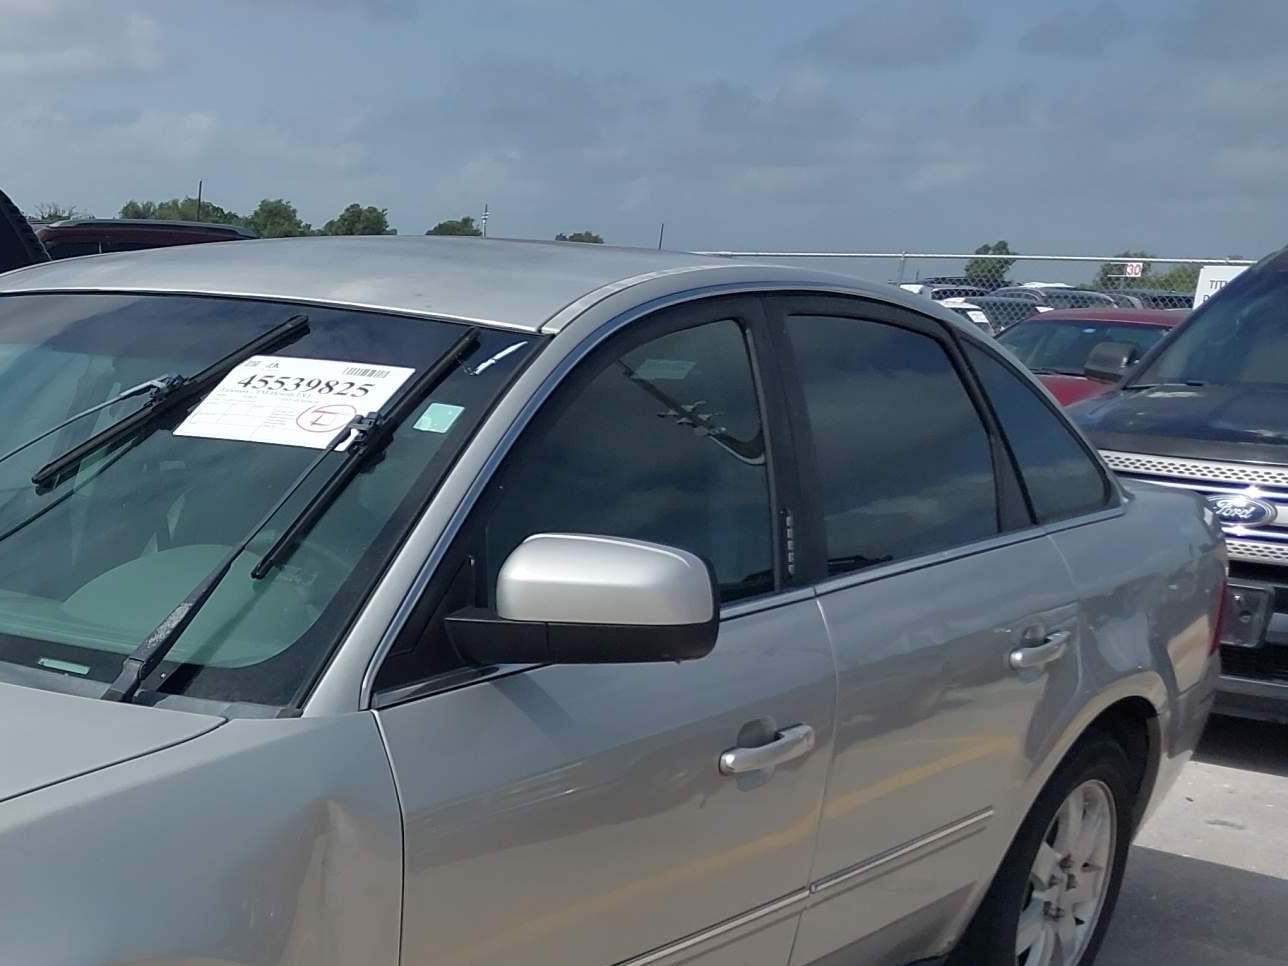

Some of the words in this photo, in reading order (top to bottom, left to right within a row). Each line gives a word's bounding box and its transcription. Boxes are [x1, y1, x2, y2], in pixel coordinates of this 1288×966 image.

[1127, 263, 1142, 275] 30
[237, 374, 376, 398] 45539825
[1215, 500, 1256, 518] Ford
